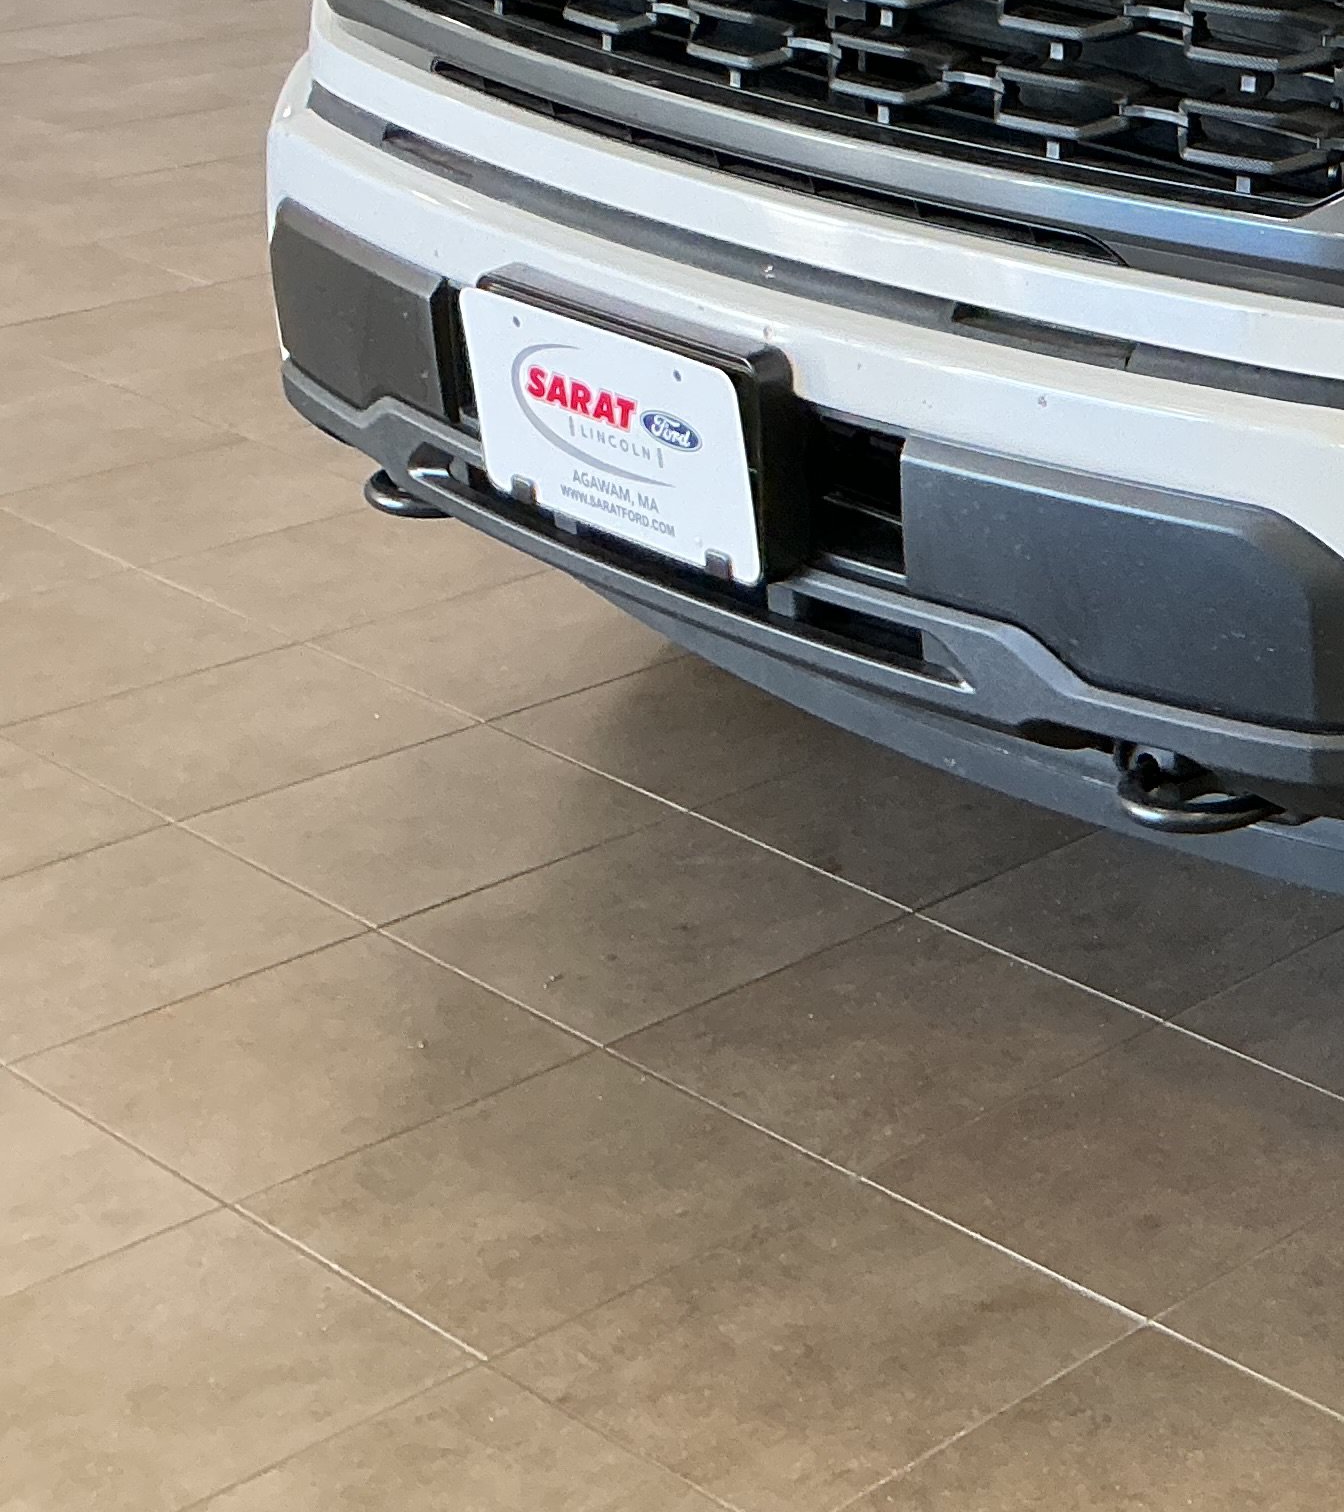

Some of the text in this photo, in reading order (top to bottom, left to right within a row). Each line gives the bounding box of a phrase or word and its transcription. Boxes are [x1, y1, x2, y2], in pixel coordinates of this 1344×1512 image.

[526, 365, 637, 431] SARAT
[580, 424, 652, 461] LINCOLN
[651, 413, 692, 448] Ford
[560, 483, 676, 537] WWW.SARATFORD.COM
[572, 469, 660, 514] AGAWAM, MA
